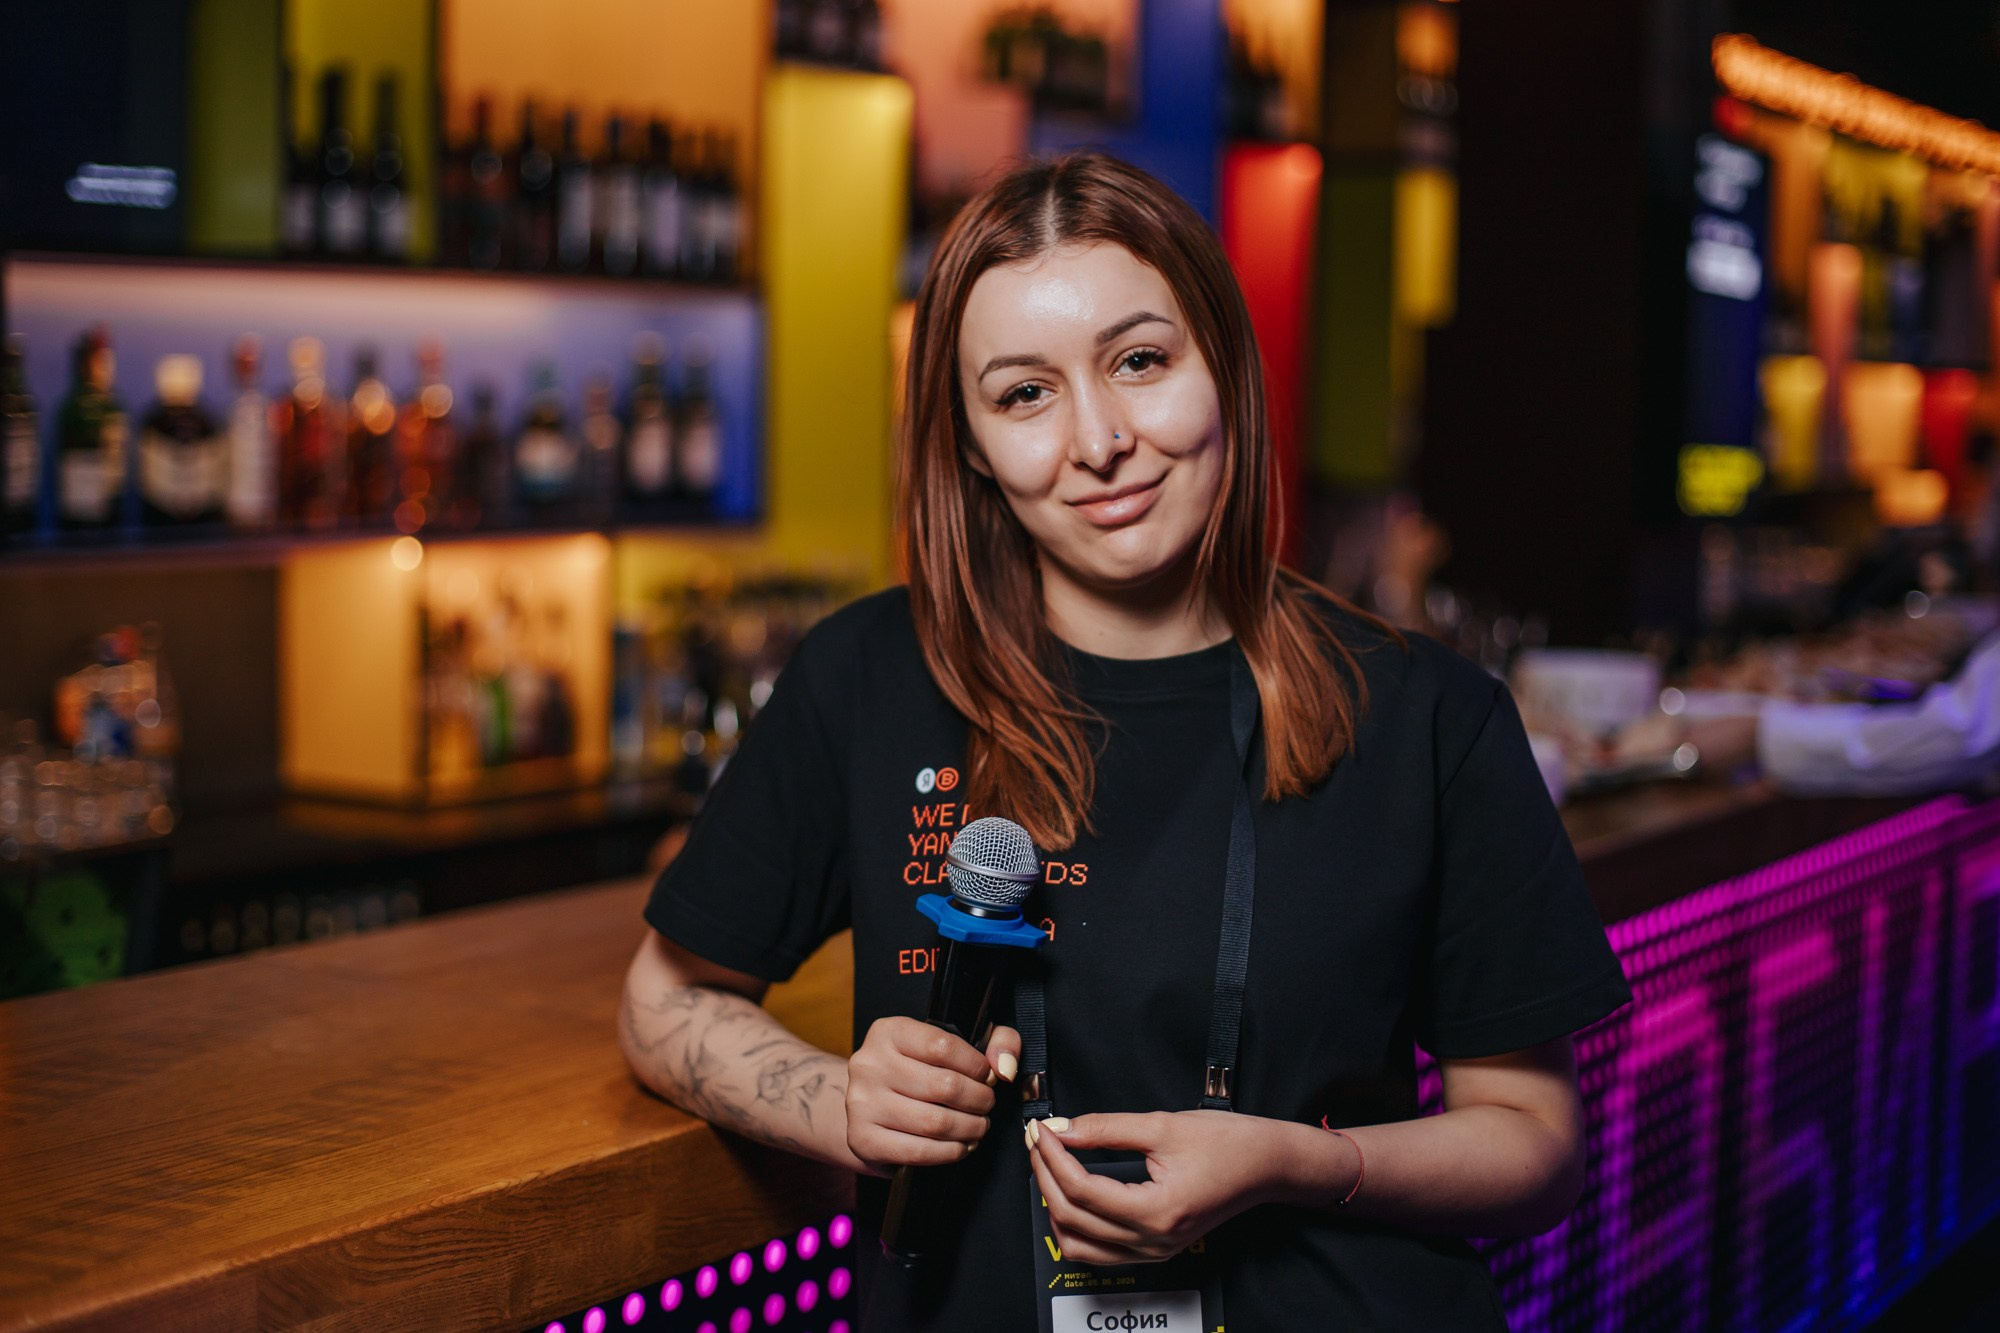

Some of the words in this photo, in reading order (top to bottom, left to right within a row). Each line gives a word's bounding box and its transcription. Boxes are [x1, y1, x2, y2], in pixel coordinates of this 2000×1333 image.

[912, 803, 956, 828] WE
[908, 831, 958, 856] YAN
[899, 948, 940, 974] EDI
[1086, 1309, 1168, 1333] София
